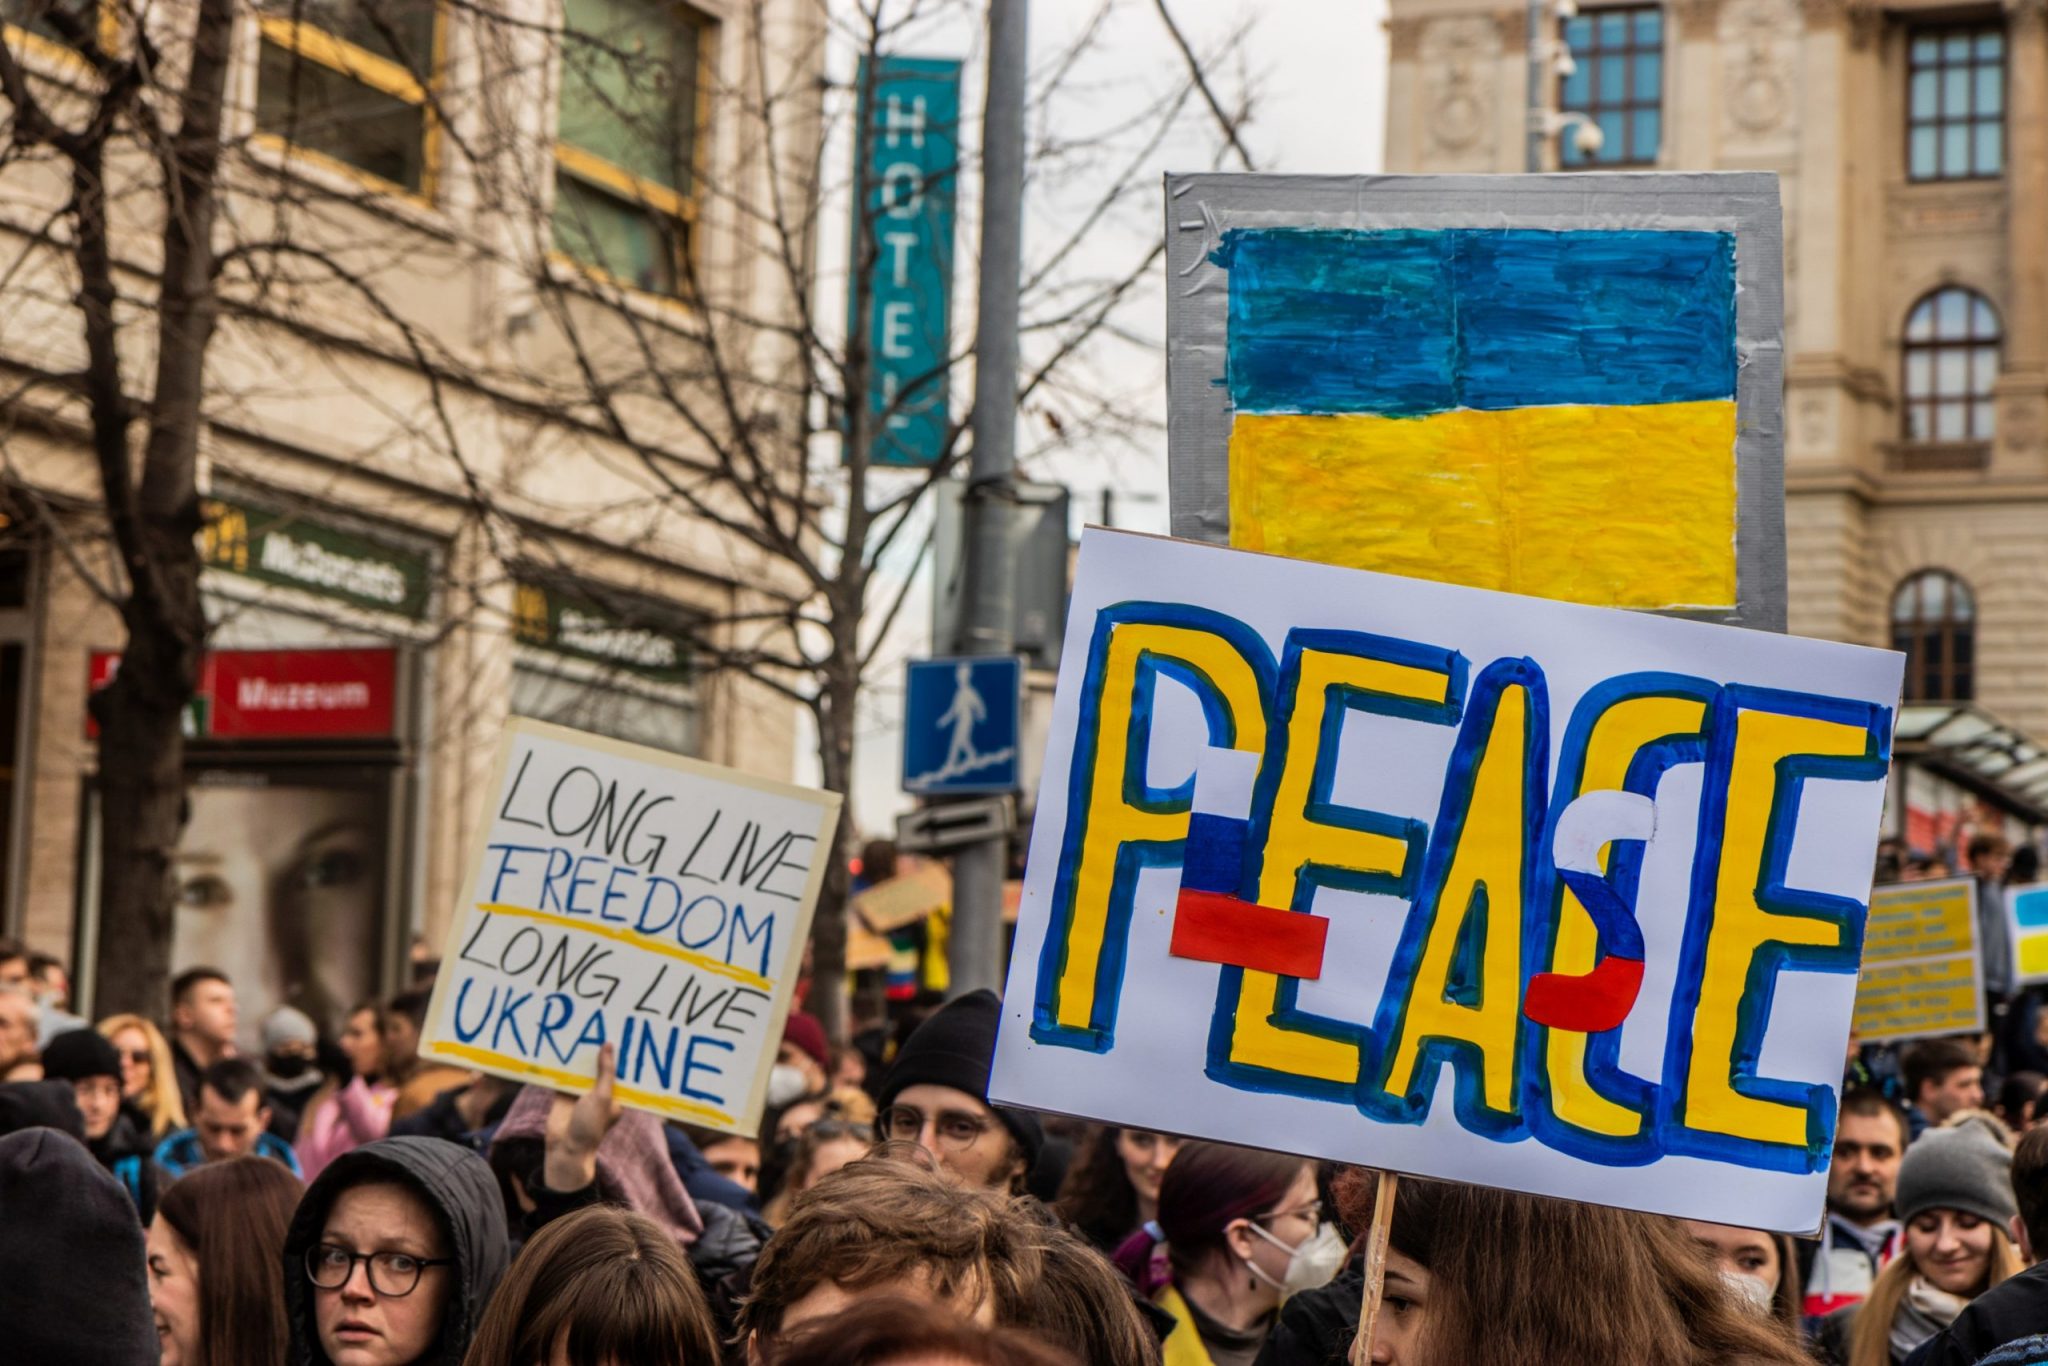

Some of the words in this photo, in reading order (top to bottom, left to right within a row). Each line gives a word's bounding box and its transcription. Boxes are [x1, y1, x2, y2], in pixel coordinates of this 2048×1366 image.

[881, 93, 926, 428] HOTEL
[237, 676, 371, 710] Muzeum
[500, 750, 675, 873] LONG
[678, 809, 818, 902] LIVE
[460, 912, 620, 1006] LONG
[634, 964, 771, 1034] LIVE
[487, 844, 775, 978] FREEDOM
[454, 977, 736, 1106] UKRAINE
